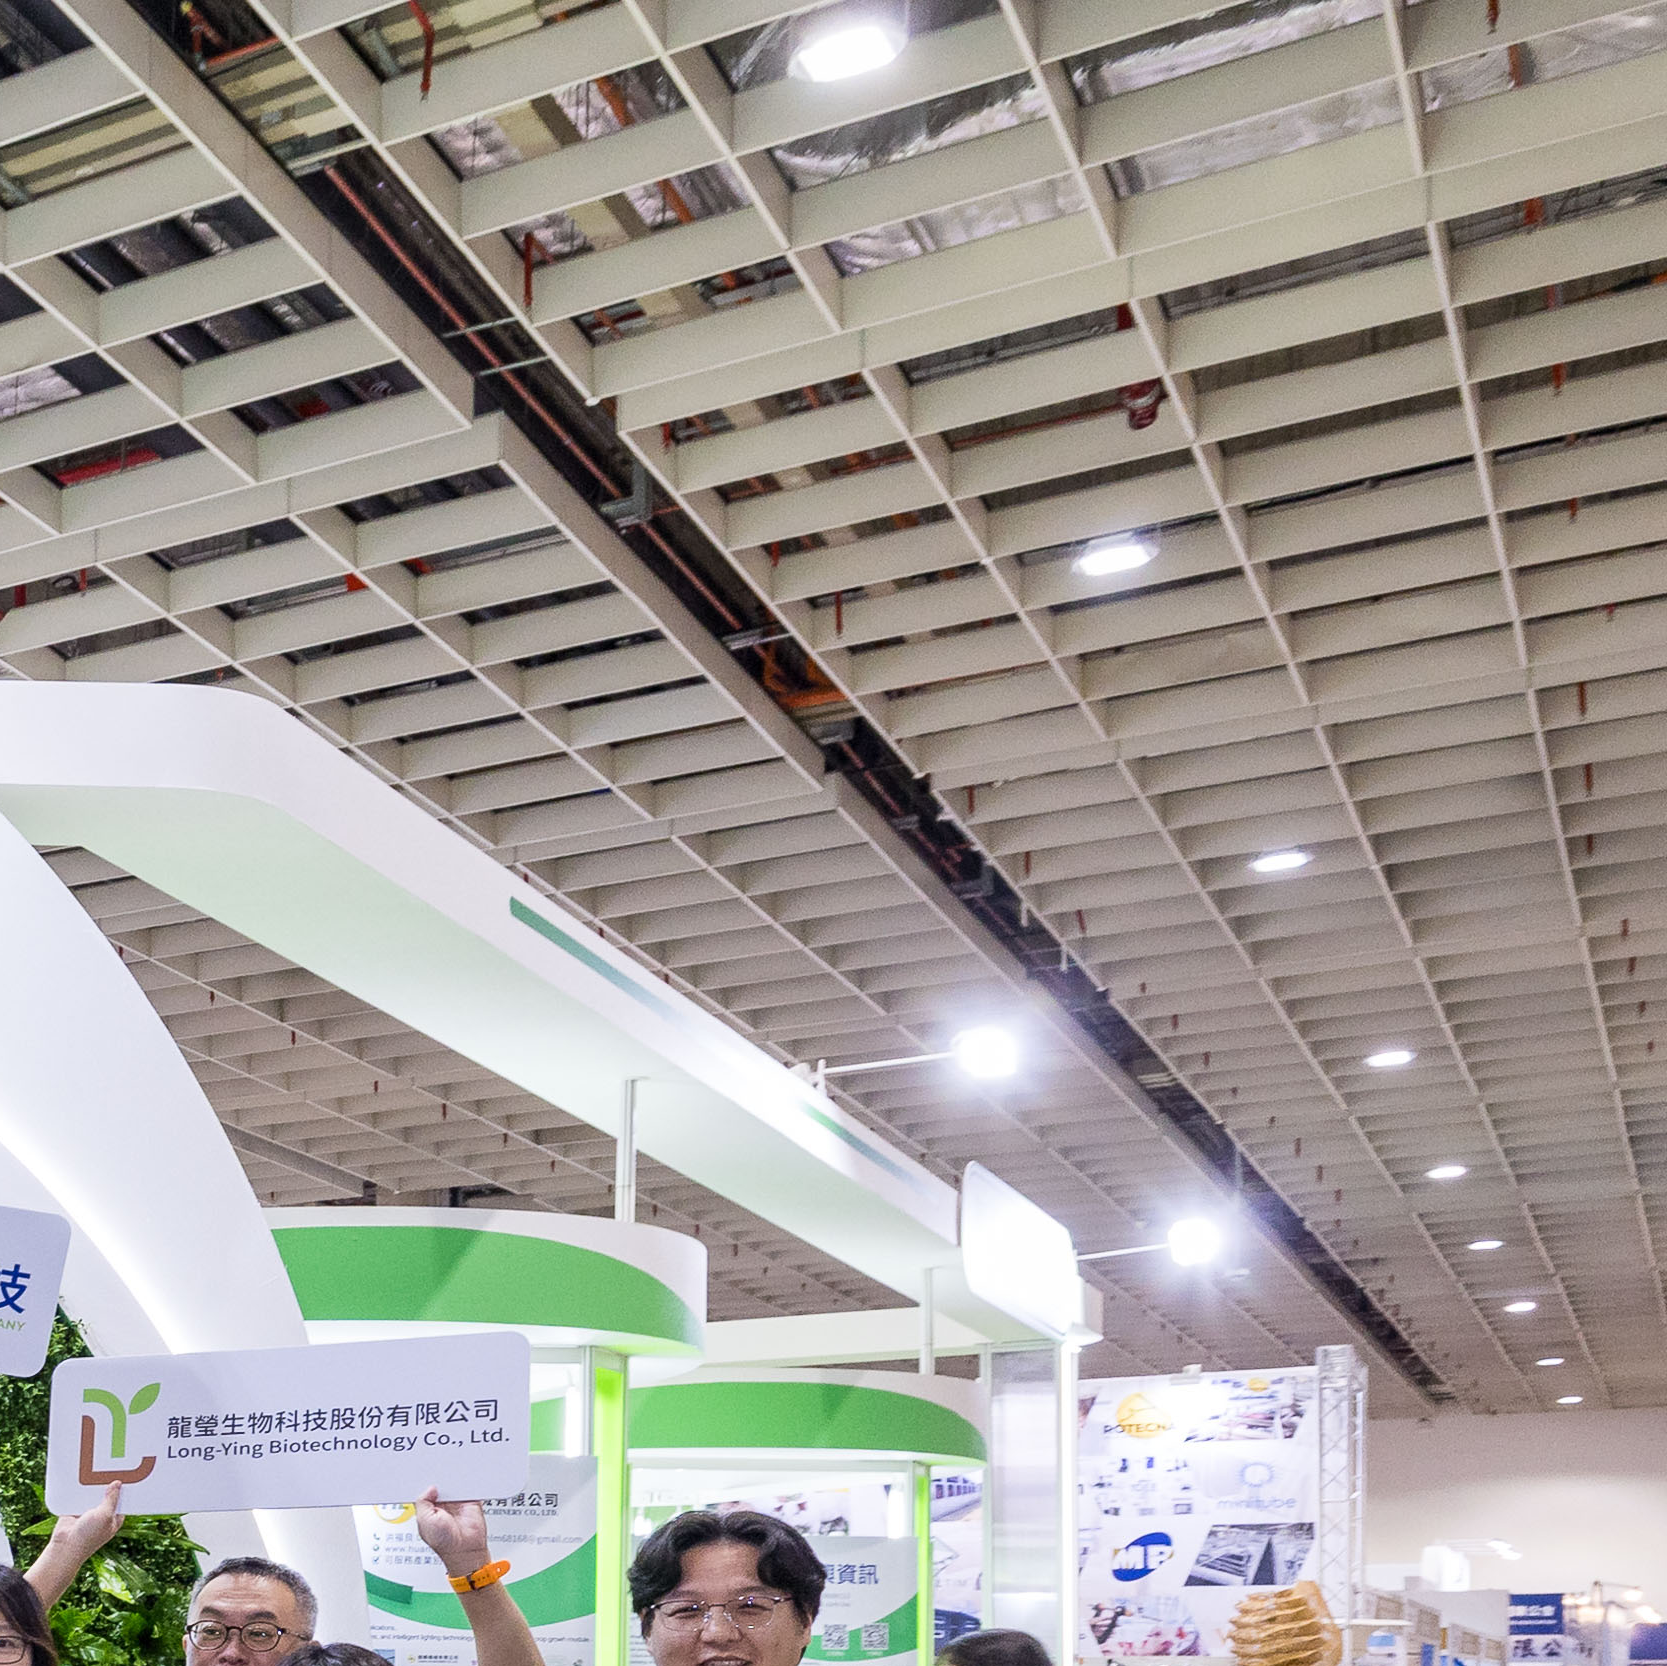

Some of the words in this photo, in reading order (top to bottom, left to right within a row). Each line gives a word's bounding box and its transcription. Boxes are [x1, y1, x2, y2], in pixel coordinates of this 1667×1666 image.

[167, 1399, 499, 1439] 龍瑩生物科技股份有限公司
[167, 1442, 264, 1461] Long-Ying
[270, 1435, 418, 1455] Biotechnology
[424, 1431, 464, 1448] Co.,
[471, 1428, 511, 1443] Ltd.
[483, 1508, 522, 1516] ACHINERY
